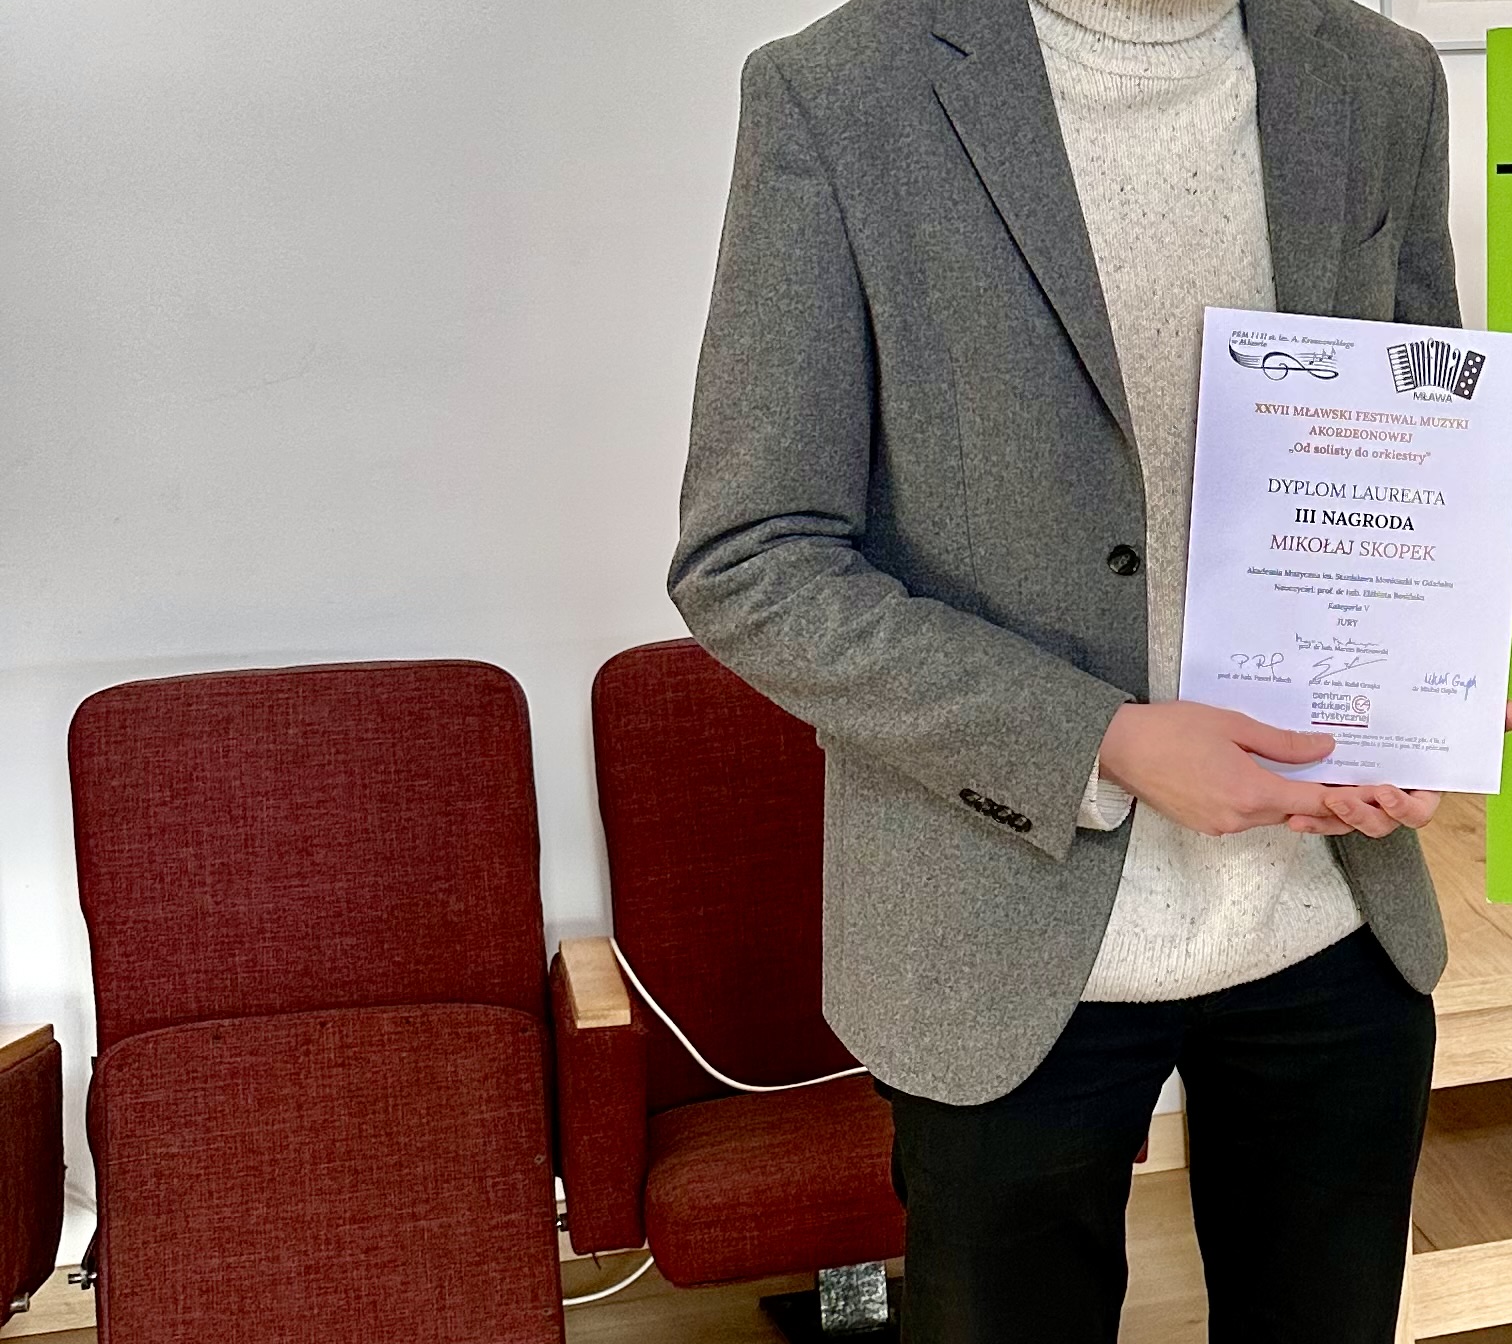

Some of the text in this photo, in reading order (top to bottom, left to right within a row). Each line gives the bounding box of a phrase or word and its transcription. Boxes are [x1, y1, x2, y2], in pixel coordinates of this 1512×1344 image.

[1413, 391, 1453, 403] MŁAWA
[1255, 403, 1469, 430] XXVII MŁAWSKI FESTIWAL MUZYKI
[1309, 425, 1413, 444] AKORDEONOWEJ
[1314, 444, 1352, 460] solisty
[1355, 446, 1369, 458] do
[1267, 478, 1446, 506] DYPLOM LAUREATA
[1294, 508, 1415, 531] III NAGRODA
[1269, 534, 1437, 562] MIKOŁAJ SKOPEK
[1336, 617, 1358, 628] JURY
[1312, 691, 1351, 701] centrum
[1311, 701, 1350, 712] edukacji
[1311, 710, 1370, 723] artystycznej
